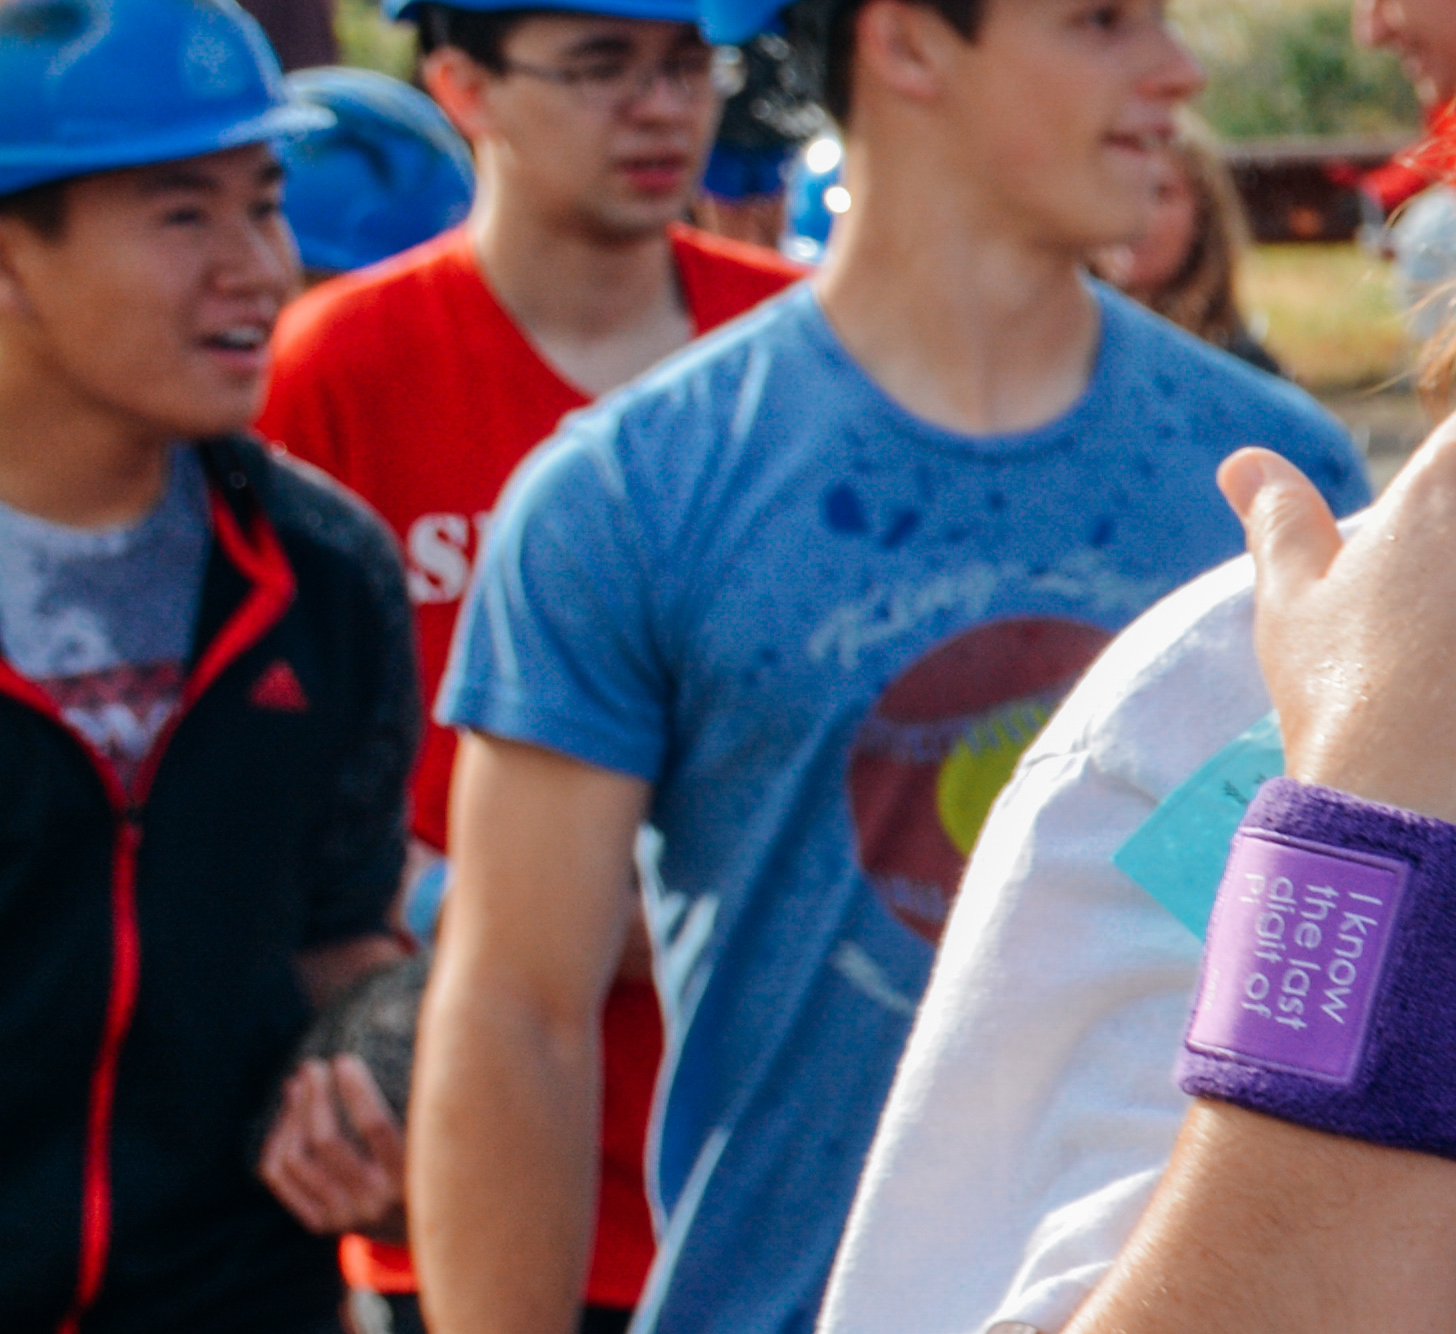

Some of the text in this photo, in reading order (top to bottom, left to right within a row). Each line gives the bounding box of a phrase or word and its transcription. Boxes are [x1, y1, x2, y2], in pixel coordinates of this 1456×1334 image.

[1240, 876, 1298, 1018] digit of
[1274, 883, 1341, 1031] the last
[1320, 890, 1384, 1025] I know
